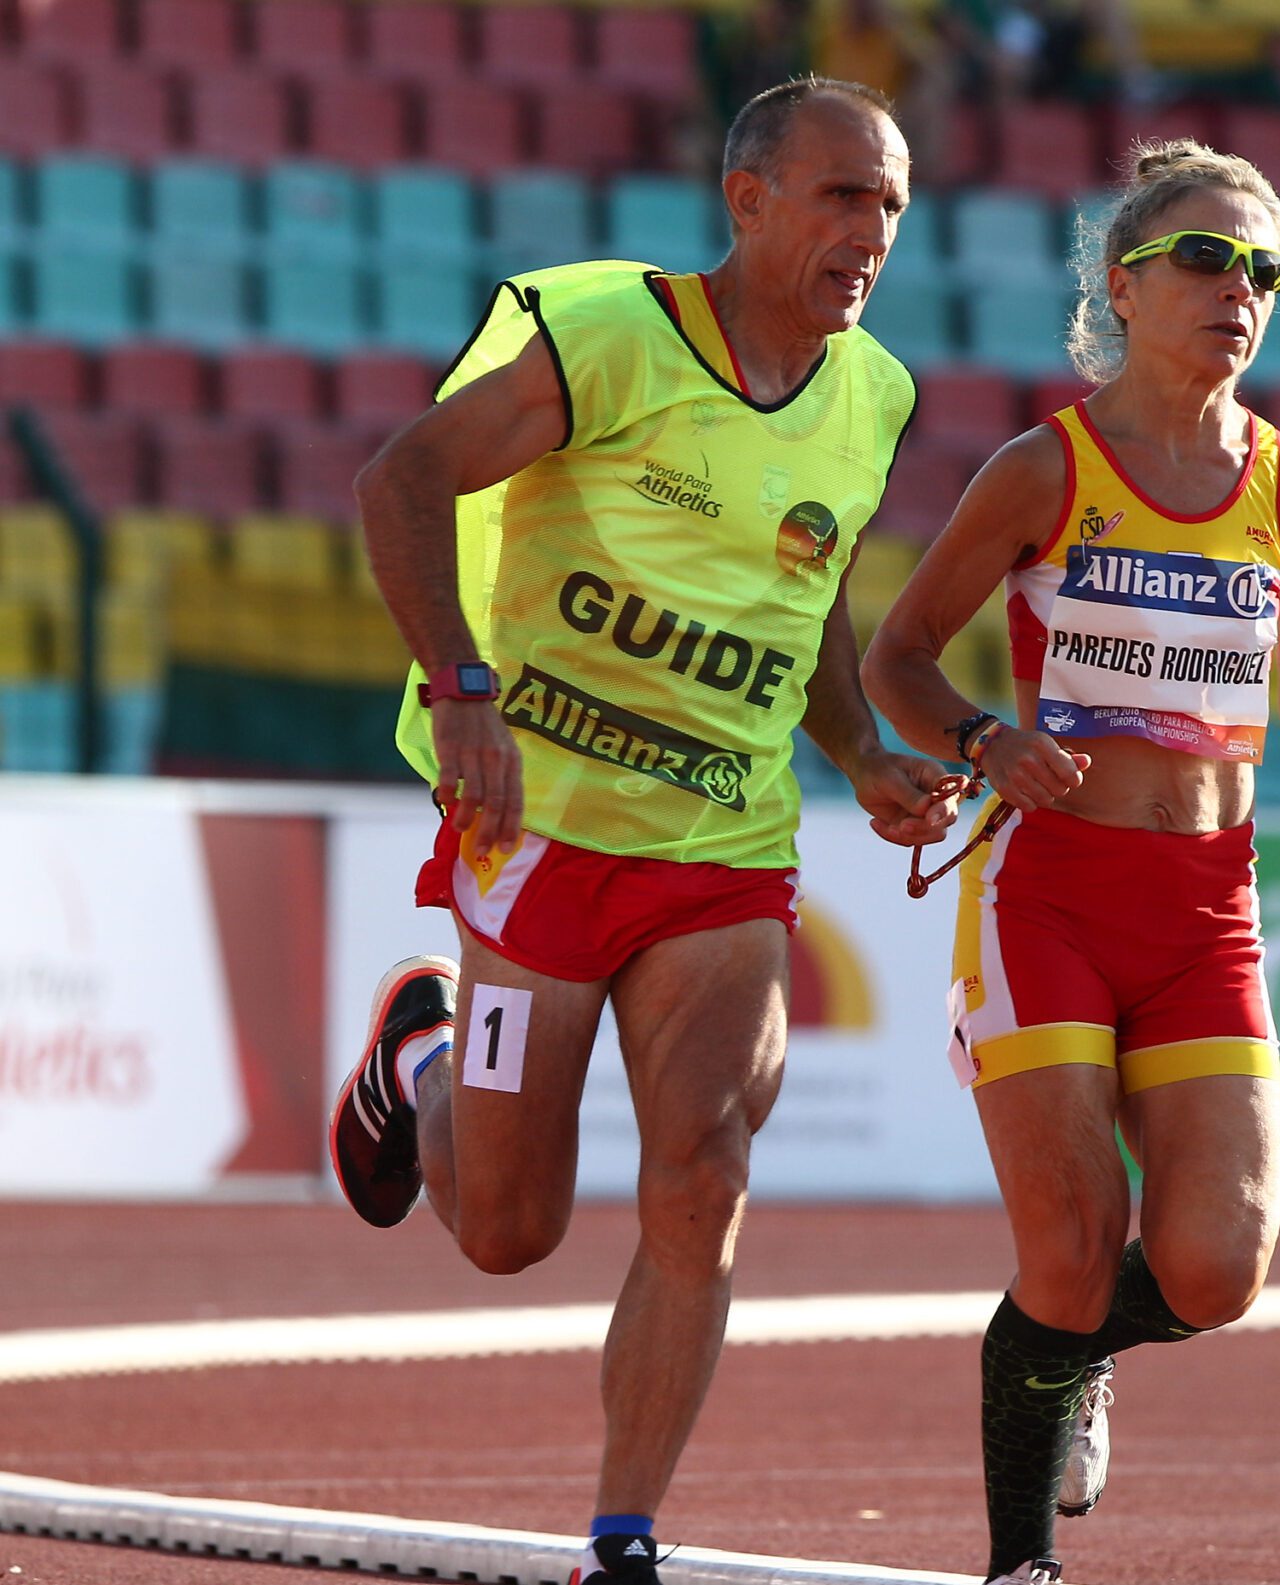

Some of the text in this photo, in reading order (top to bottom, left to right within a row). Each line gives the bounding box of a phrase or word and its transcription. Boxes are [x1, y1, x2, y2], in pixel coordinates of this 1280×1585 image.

[636, 474, 723, 518] Athletics
[645, 460, 712, 493] World Para
[1076, 555, 1217, 604] Allianz
[558, 571, 795, 709] GUIDE
[1051, 630, 1154, 678] PAREDES
[504, 677, 689, 782] Allianz
[1094, 708, 1118, 719] BERLIN
[1163, 715, 1181, 727] PARA
[1109, 717, 1146, 729] EUROPEAN
[484, 1006, 504, 1070] 1
